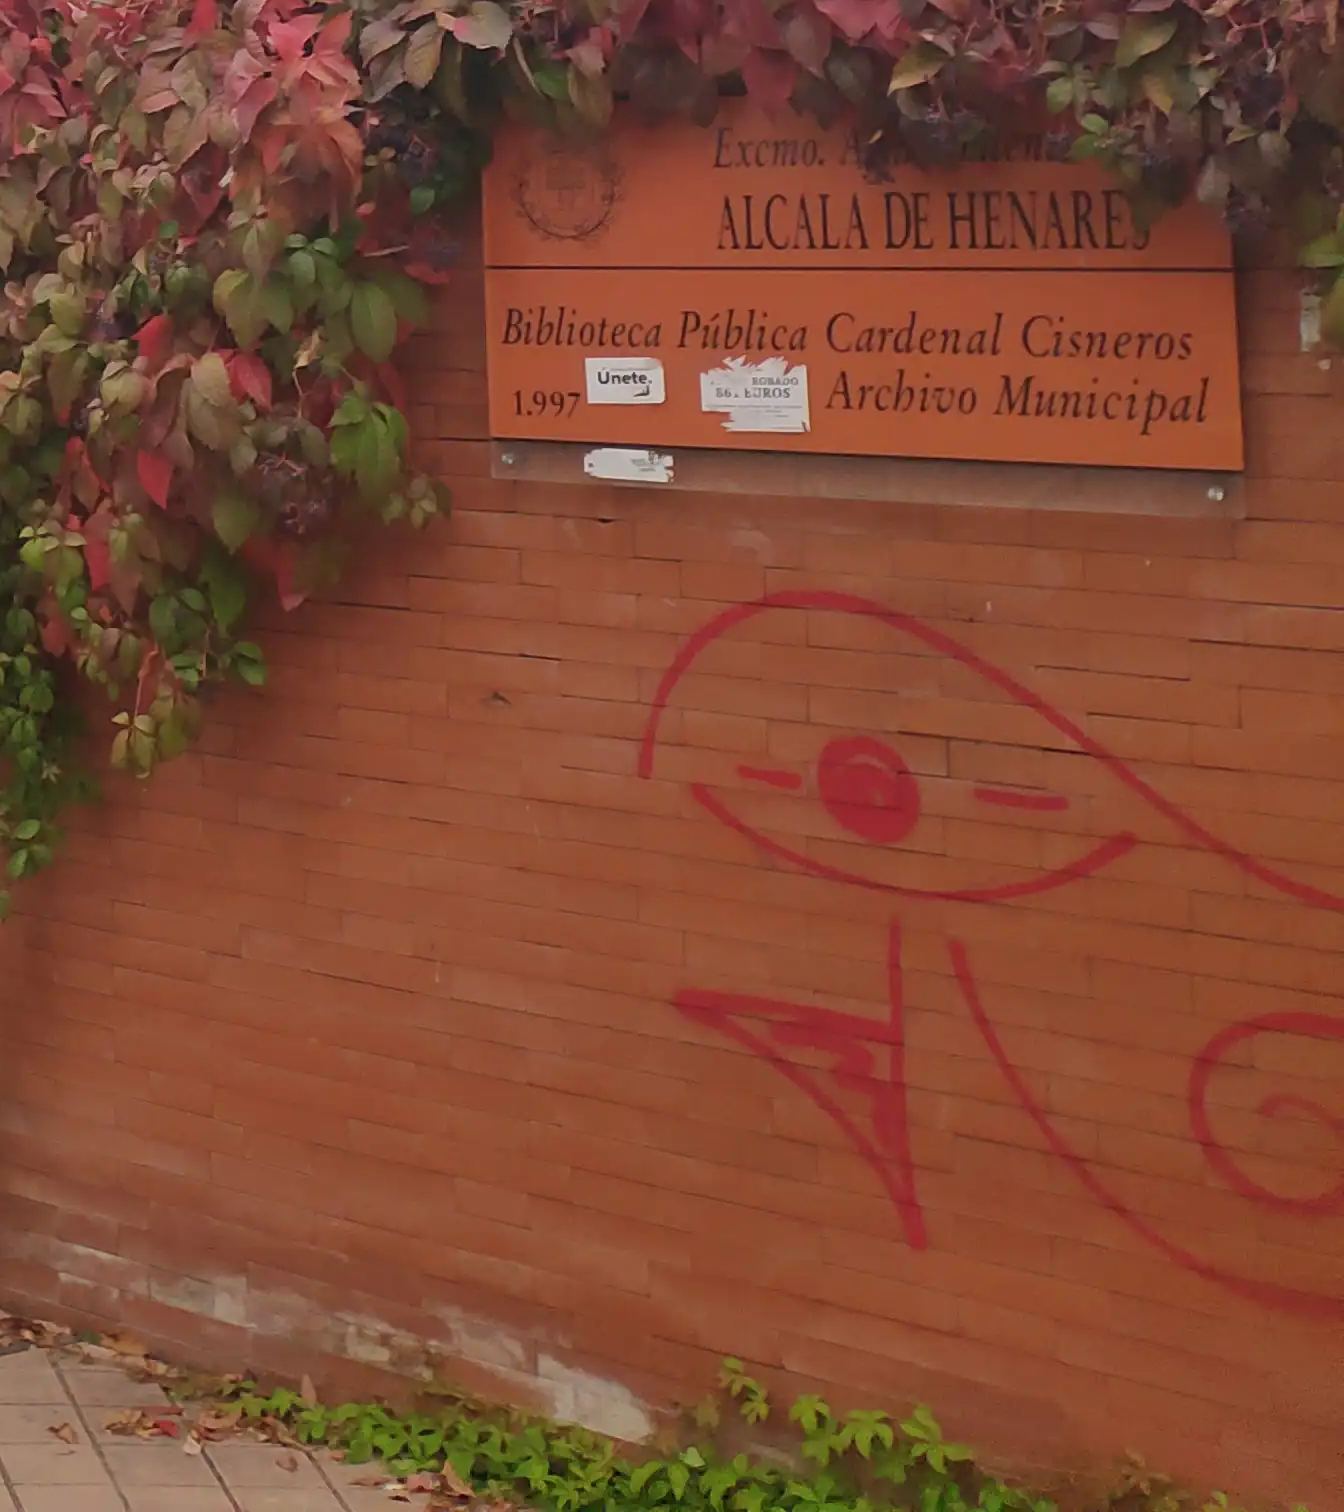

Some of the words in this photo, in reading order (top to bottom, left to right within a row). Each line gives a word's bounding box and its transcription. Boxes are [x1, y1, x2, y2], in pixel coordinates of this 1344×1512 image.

[713, 127, 824, 169] Excmo.
[884, 191, 934, 250] DE
[501, 306, 663, 349] Biblioteca
[676, 308, 809, 352] Pública
[825, 311, 1003, 356] Cardenal
[1021, 314, 1194, 361] Cisneros
[597, 367, 653, 385] Únete.
[512, 390, 582, 419] 1.997
[825, 368, 978, 415] Archivo
[992, 374, 1211, 436] Municipal
